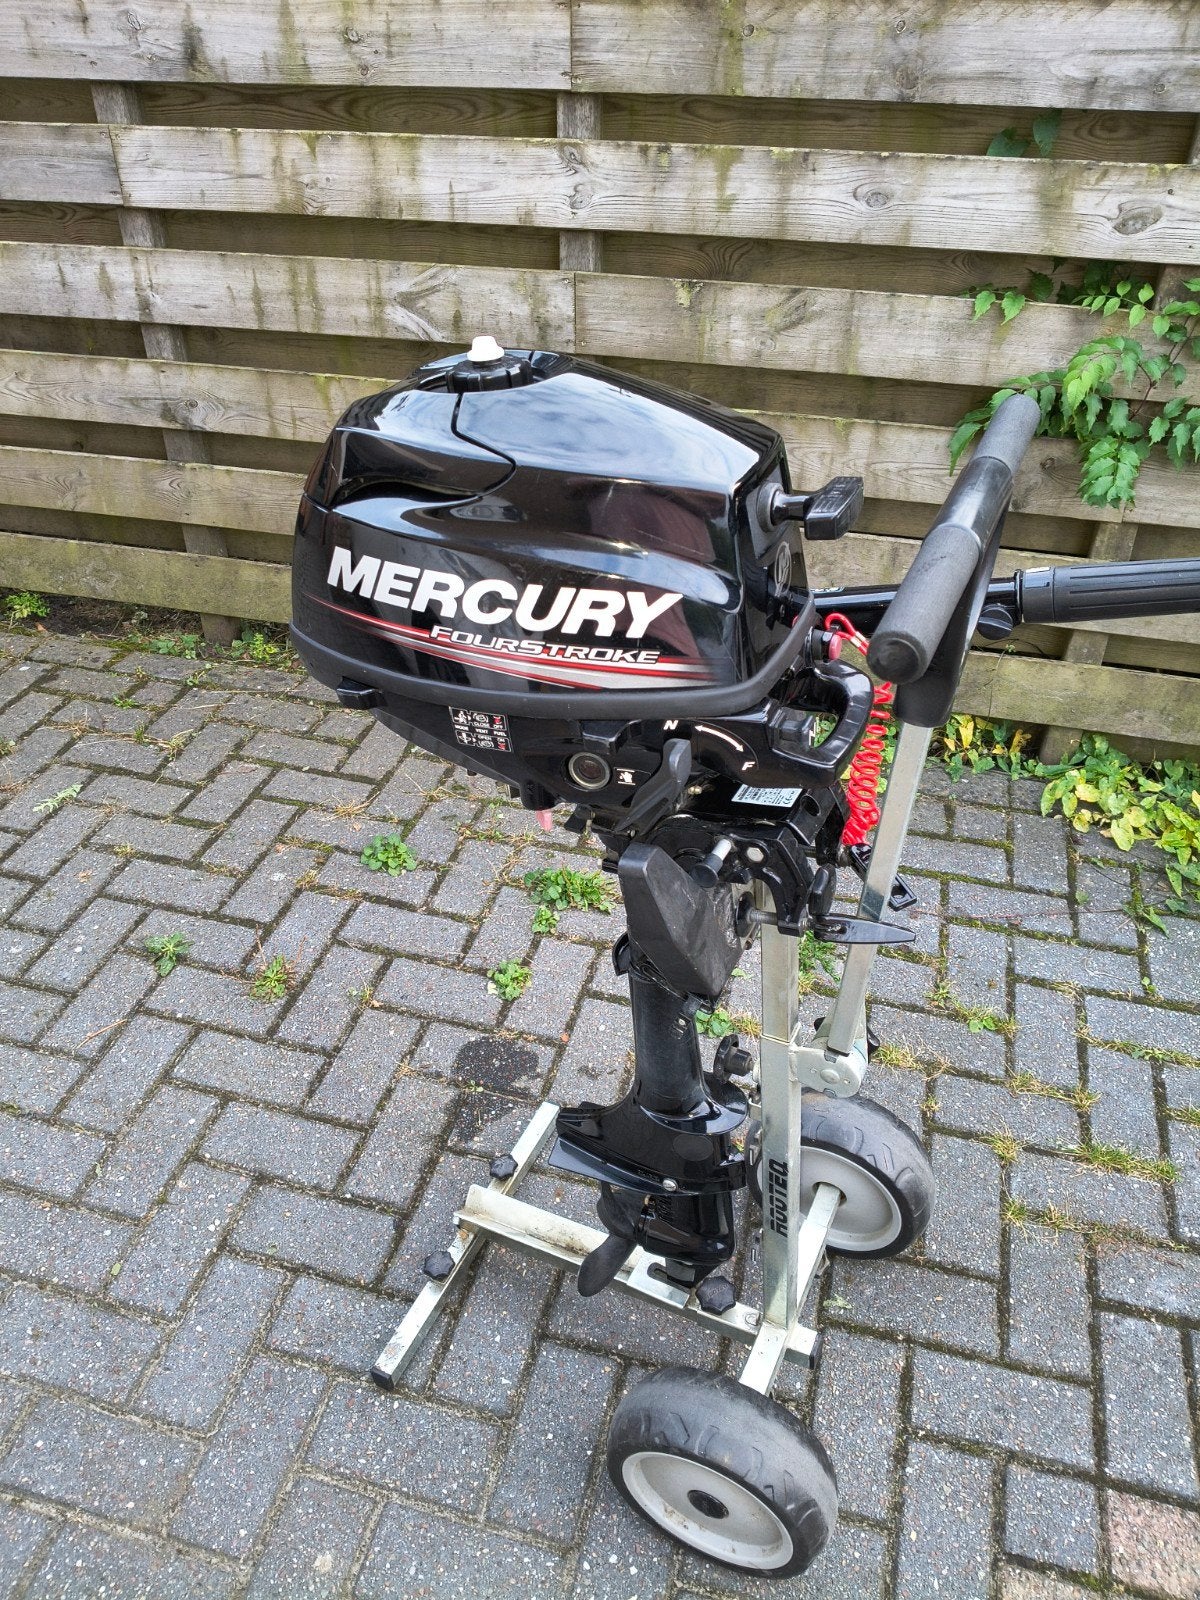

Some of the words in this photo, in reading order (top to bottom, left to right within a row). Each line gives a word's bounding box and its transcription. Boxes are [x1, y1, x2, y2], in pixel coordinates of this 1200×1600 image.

[327, 546, 683, 639] MERCURY
[430, 625, 661, 664] FOURSTROKE
[663, 719, 679, 730] N
[741, 761, 756, 771] F
